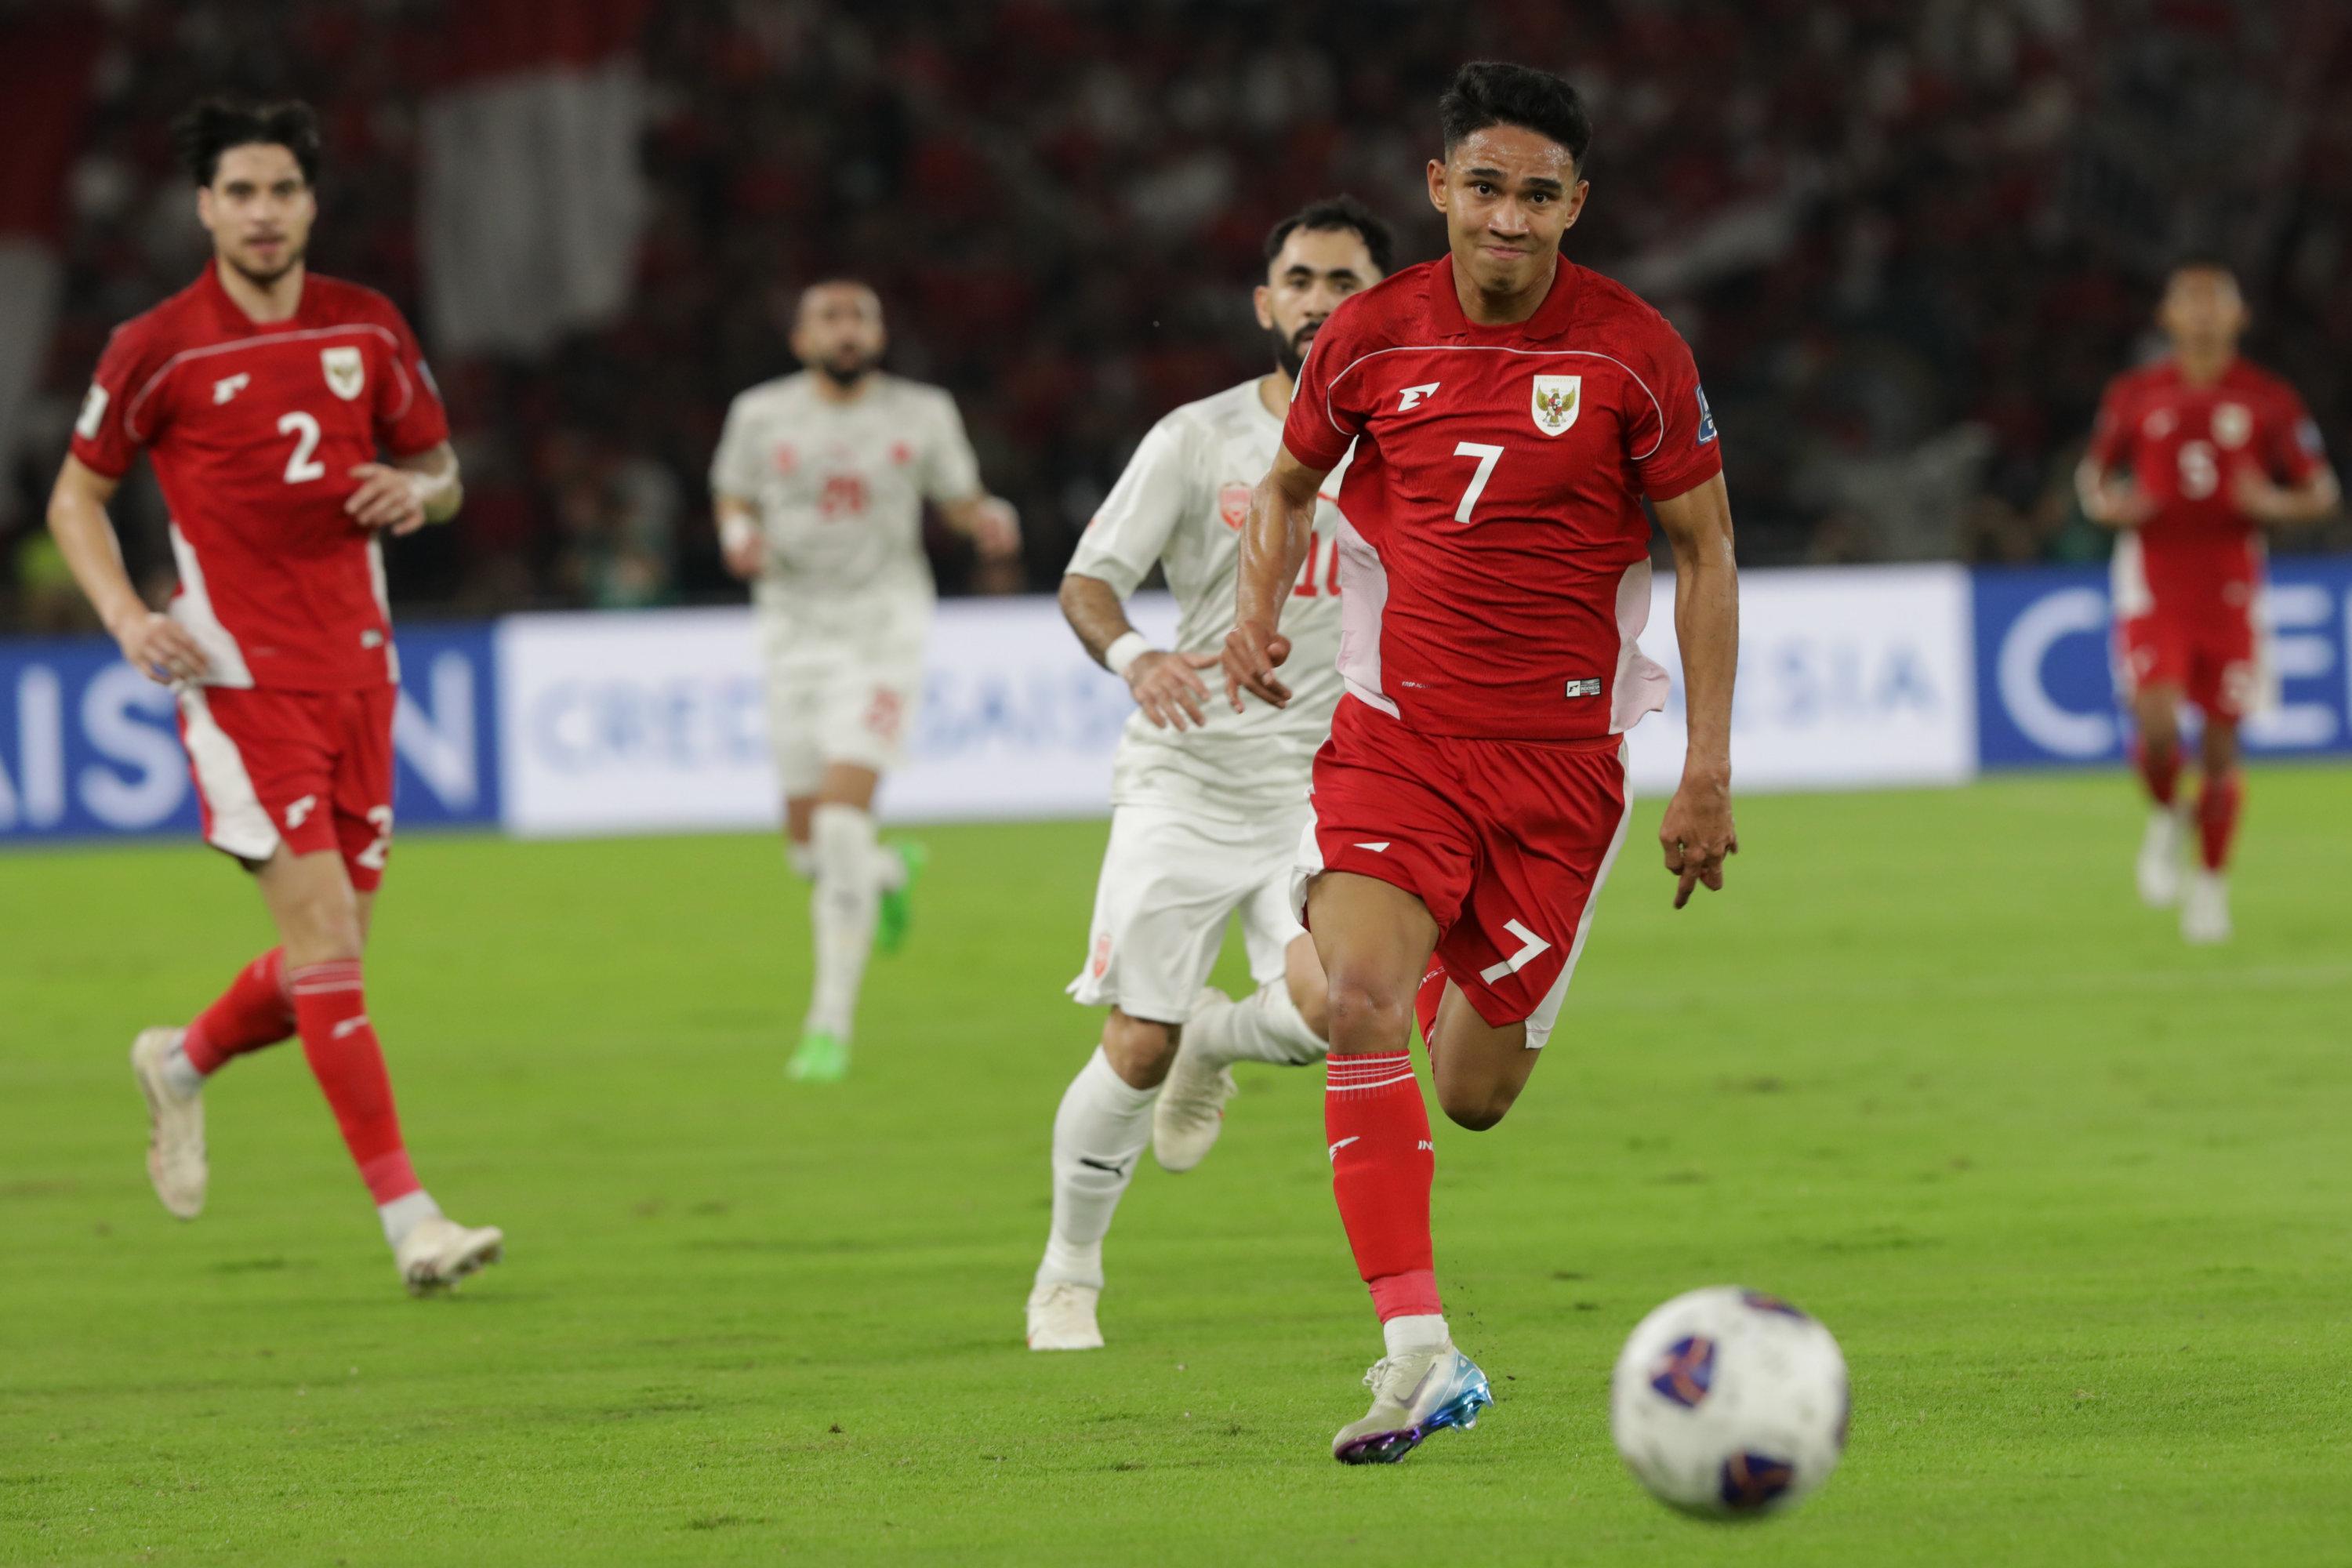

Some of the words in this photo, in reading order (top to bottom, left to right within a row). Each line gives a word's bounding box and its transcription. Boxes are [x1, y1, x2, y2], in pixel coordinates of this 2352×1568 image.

[278, 411, 325, 483] 2
[1453, 441, 1505, 524] 7
[356, 804, 394, 870] 2
[1481, 918, 1552, 985] 7
